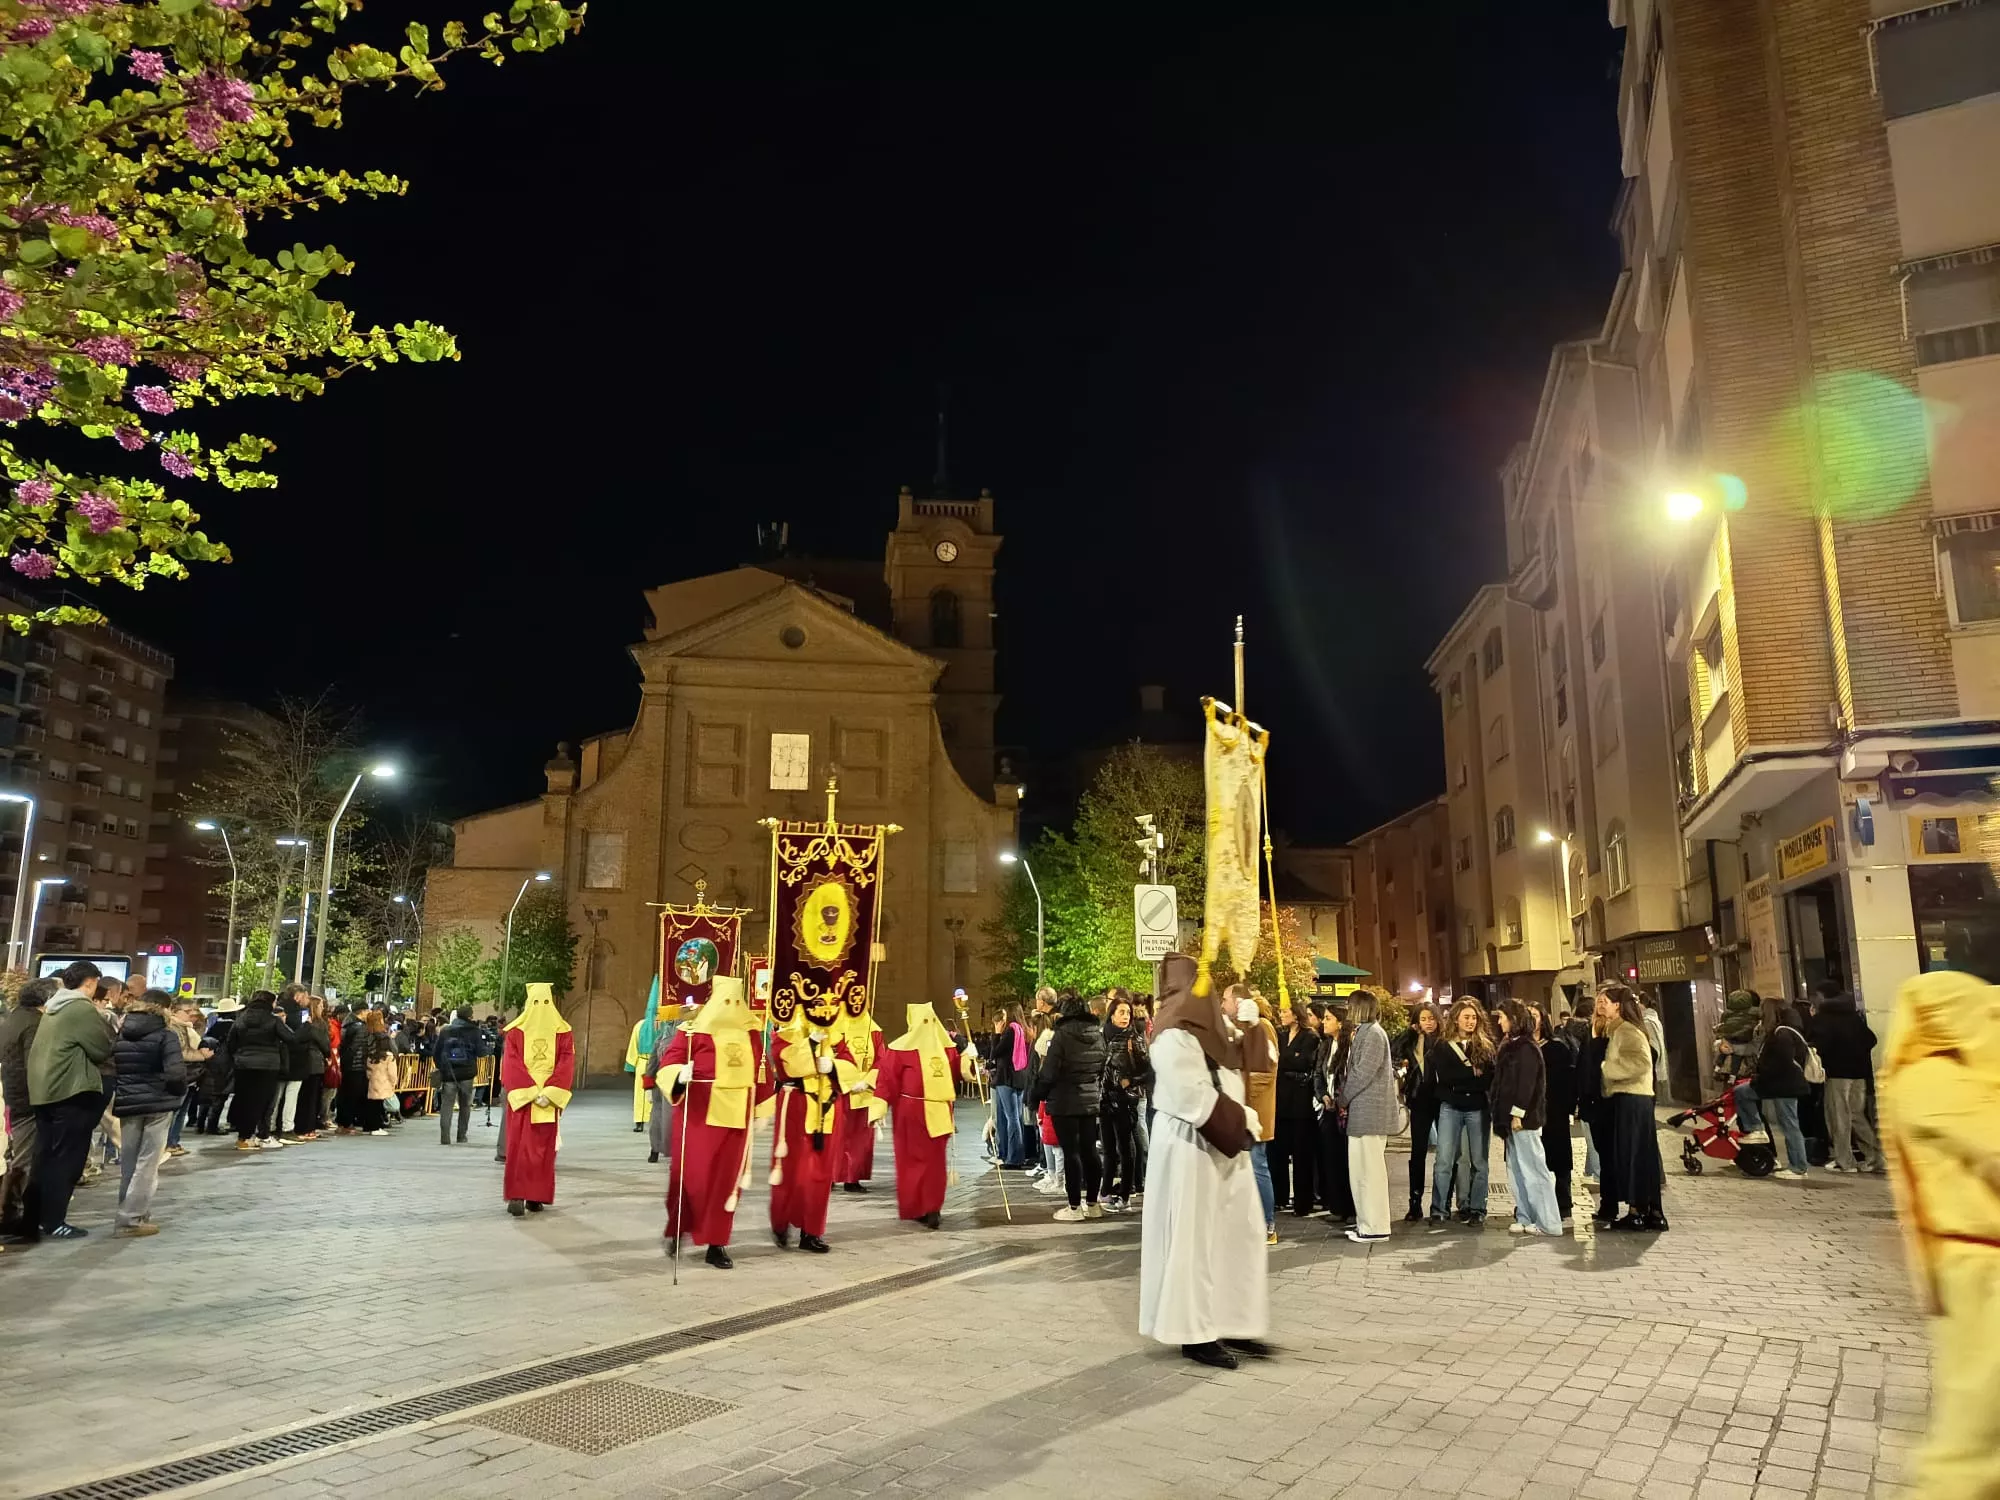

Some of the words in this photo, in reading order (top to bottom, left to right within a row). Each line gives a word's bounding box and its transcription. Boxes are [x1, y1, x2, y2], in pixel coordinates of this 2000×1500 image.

[1783, 837, 1803, 859] MOBILE
[1802, 826, 1822, 852] HOUSE
[1639, 956, 1686, 978] ESTUDIANTES
